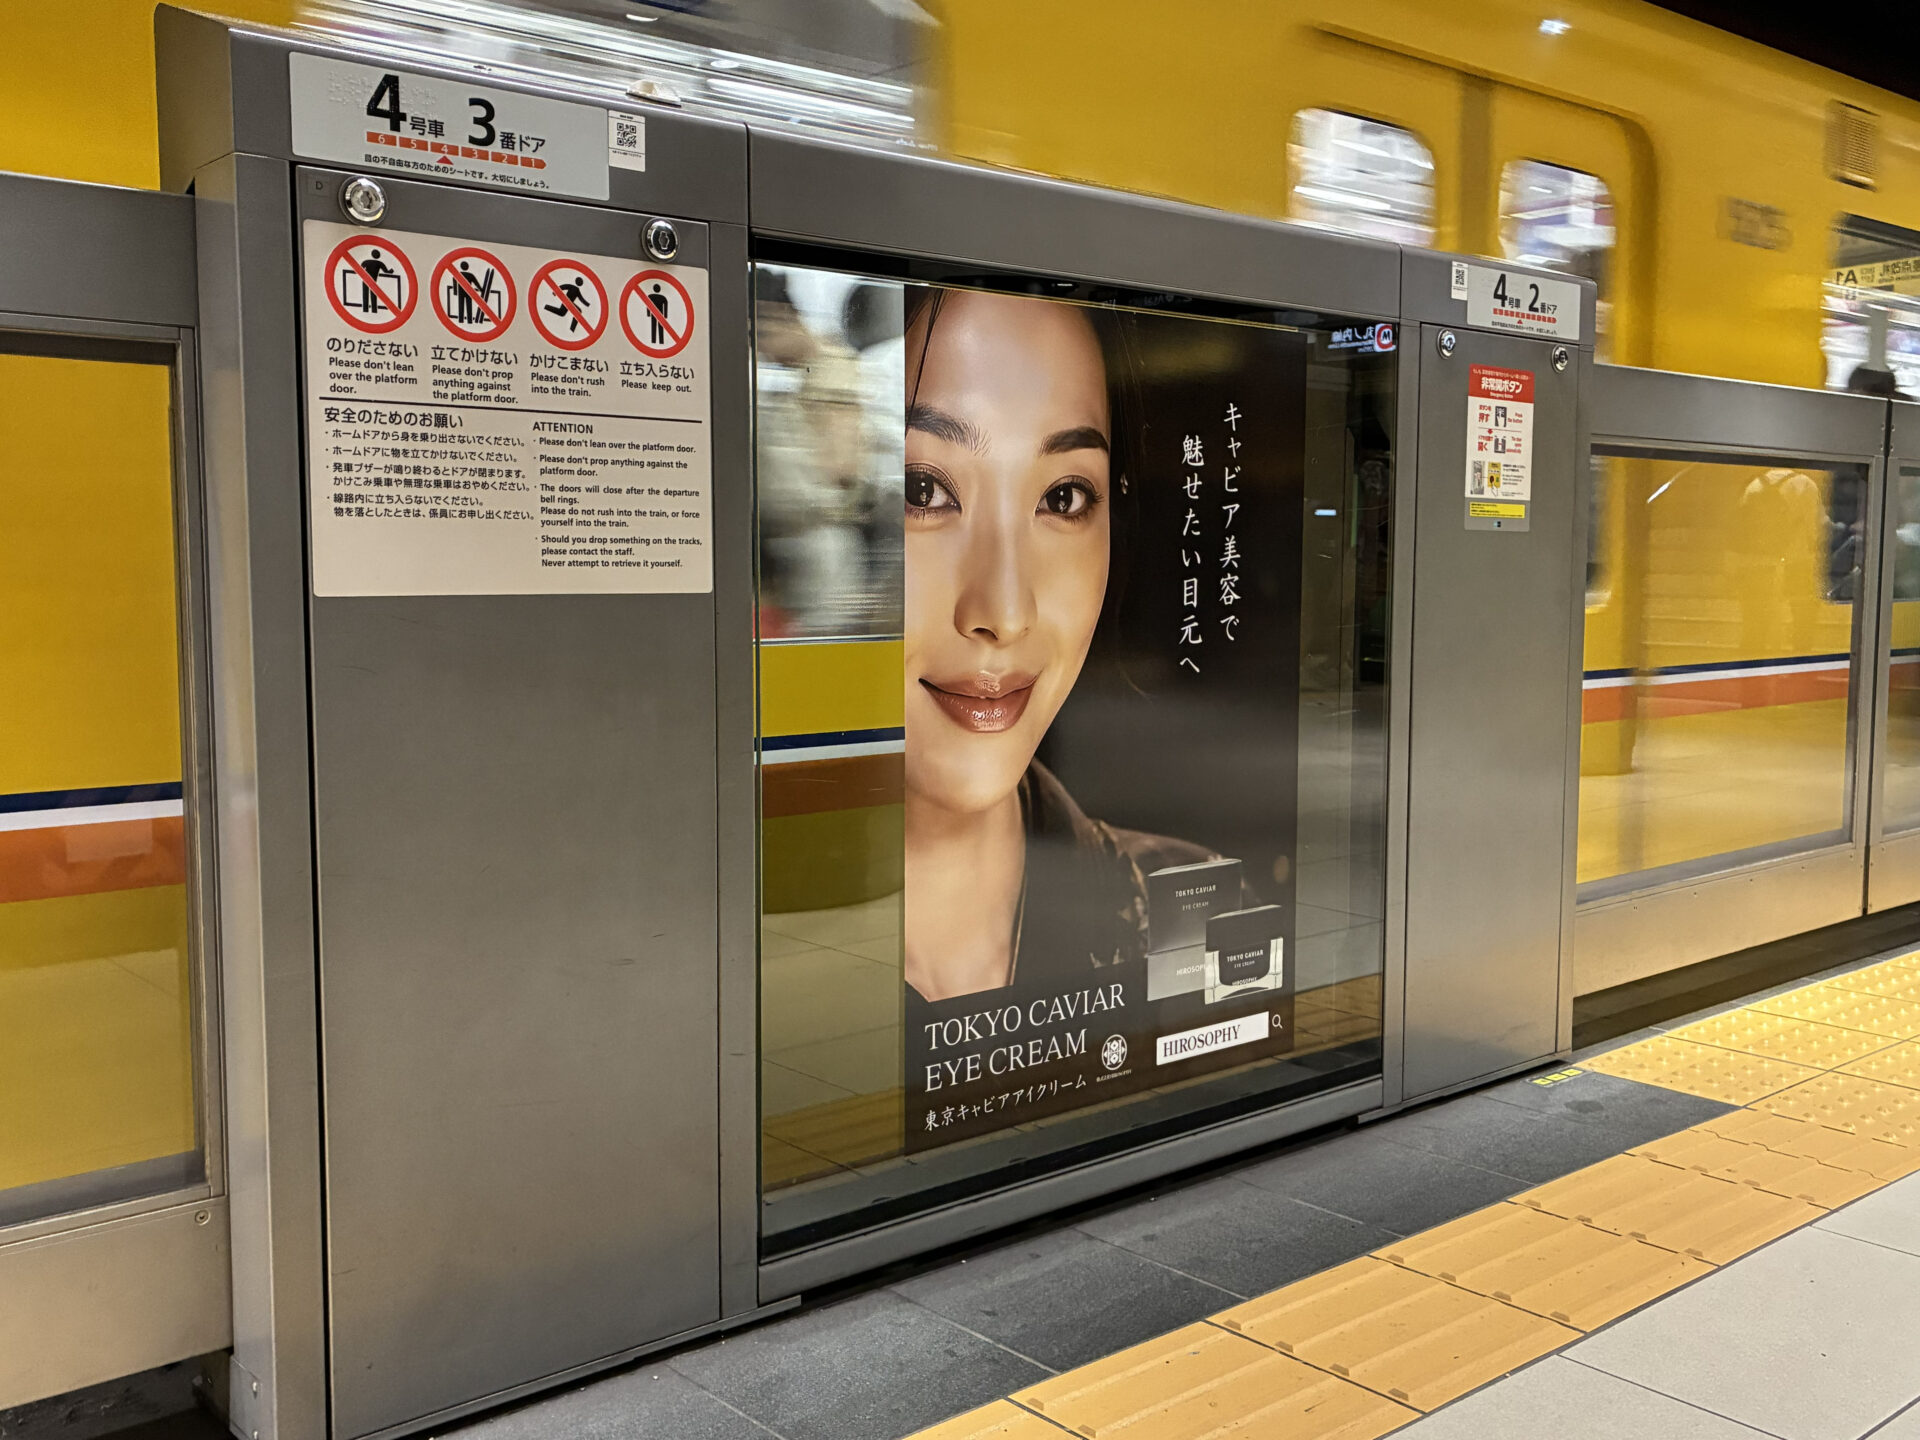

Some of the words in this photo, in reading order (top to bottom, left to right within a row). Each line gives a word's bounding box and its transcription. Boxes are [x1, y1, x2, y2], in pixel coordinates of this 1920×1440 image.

[366, 73, 445, 138] 4号車
[468, 97, 546, 153] 3番ドア
[378, 134, 386, 145] 6
[410, 139, 417, 149] 5
[441, 144, 449, 154] 4
[473, 149, 479, 158] 3
[502, 154, 508, 164] 2
[530, 158, 535, 168] 1
[315, 181, 323, 190] D
[326, 337, 418, 358] のりださない
[431, 344, 518, 365] 立てかけない
[329, 357, 361, 368] Please
[364, 359, 390, 370] don't
[394, 362, 414, 372] lean
[529, 353, 609, 373] かけこまない
[619, 360, 695, 380] 立ち入らない
[329, 372, 352, 381] over
[356, 372, 372, 382] the
[375, 374, 418, 385] platform
[432, 365, 462, 375] Please
[464, 367, 490, 378] don't
[492, 370, 514, 380] prop
[531, 372, 558, 383] Please
[561, 374, 584, 384] don't
[586, 377, 605, 386] rush
[330, 383, 357, 394] door.
[432, 378, 475, 390] anything
[477, 380, 511, 392] against
[531, 385, 549, 394] into
[552, 386, 566, 396] the
[568, 387, 592, 397] train.
[621, 380, 647, 390] Please
[651, 382, 672, 393] keep
[676, 384, 692, 393] out.
[432, 390, 448, 400] the
[451, 391, 492, 404] platform
[494, 393, 519, 404] door.
[324, 406, 464, 429] 安全のためのお願い
[532, 422, 594, 434] ATTENTION
[539, 438, 564, 447] Please
[566, 438, 588, 448] don't
[590, 440, 606, 448] lean
[608, 442, 625, 450] over
[628, 442, 640, 450] the
[642, 442, 674, 452] platform
[676, 444, 696, 453] door.
[332, 445, 517, 463] ホームドアに物を立てかけないでください。
[540, 454, 565, 464] Please
[567, 456, 588, 464] don't
[590, 458, 608, 466] prop
[610, 458, 644, 468] anything
[646, 460, 674, 470] against
[676, 460, 688, 469] the
[540, 466, 574, 476] platform
[577, 468, 598, 476] door.
[540, 484, 555, 492] The
[558, 484, 582, 493] doors
[585, 485, 600, 494] will
[603, 486, 622, 494] close
[626, 486, 644, 495] after
[648, 488, 660, 496] the
[663, 488, 700, 498] departure
[540, 495, 556, 503] bell
[558, 496, 580, 506] rings.
[540, 506, 566, 516] Please
[568, 507, 579, 516] do
[581, 508, 594, 516] not
[598, 508, 614, 516] rush
[616, 508, 632, 517] into
[634, 508, 646, 518] the
[649, 510, 669, 518] train,
[682, 510, 700, 518] force
[540, 518, 574, 528] yourself
[576, 519, 592, 527] into
[594, 519, 607, 528] the
[608, 520, 629, 528] train.
[1219, 402, 1242, 641] キャビア美容で
[541, 536, 570, 544] Should
[572, 537, 586, 546] you
[588, 536, 608, 546] drop
[610, 536, 650, 546] something
[664, 536, 676, 545] the
[678, 536, 702, 546] tracks,
[542, 548, 567, 556] please
[569, 548, 598, 556] contact
[600, 548, 612, 556] the
[614, 548, 635, 556] staff.
[1178, 435, 1204, 673] 魅せたい目元へ
[542, 559, 565, 568] Never
[568, 560, 599, 569] attempt
[601, 560, 610, 568] to
[612, 560, 641, 568] retrieve
[642, 560, 649, 568] it
[650, 560, 683, 569] yourself.
[1175, 889, 1194, 898] TOKYO
[1226, 953, 1243, 962] TOKYO
[1244, 949, 1263, 959] CAVIAR
[925, 1005, 1022, 1050] TOKYO
[1029, 983, 1126, 1026] CAVIAR
[1163, 1024, 1240, 1058] HIROSOPHY
[925, 1054, 982, 1093] EYE
[989, 1028, 1088, 1075] CREAM
[924, 1074, 1087, 1132] 東京キャビアアイクリーム
